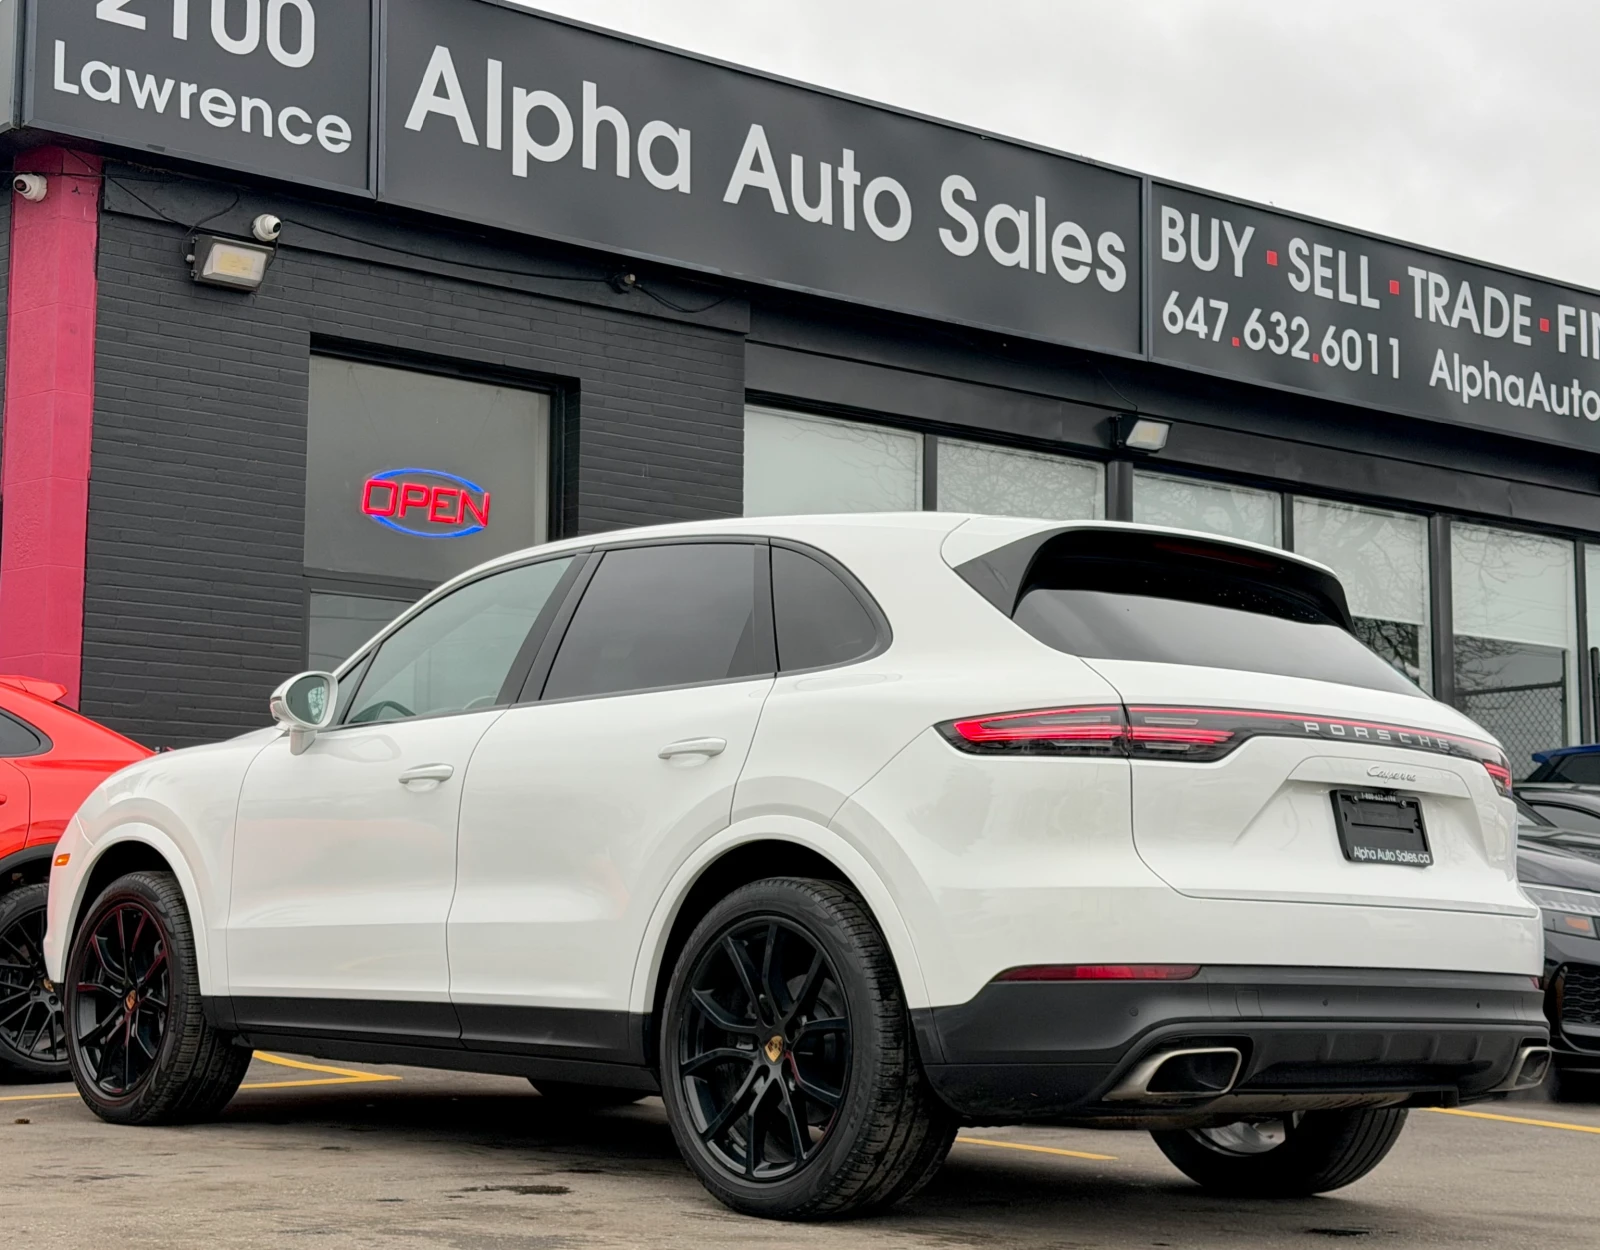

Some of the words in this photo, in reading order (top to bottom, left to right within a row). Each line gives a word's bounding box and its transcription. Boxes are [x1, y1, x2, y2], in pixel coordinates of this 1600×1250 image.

[53, 39, 352, 154] Lawrence
[404, 44, 692, 194] Alpha
[723, 123, 912, 242] Auto
[938, 174, 1127, 293] Sales
[1161, 205, 1255, 278] BUY
[1287, 237, 1380, 310] SELL
[1408, 265, 1532, 346] TRADE
[1162, 290, 1399, 379] 647.632.6011
[1429, 348, 1600, 422] AlphaAuto
[362, 479, 490, 527] OPEN
[1303, 721, 1450, 750] PORSCHE
[1366, 764, 1416, 784] Cayenne
[1353, 845, 1377, 861] Alpha
[1377, 848, 1396, 862] Auto
[1395, 849, 1431, 864] Sales.ca
